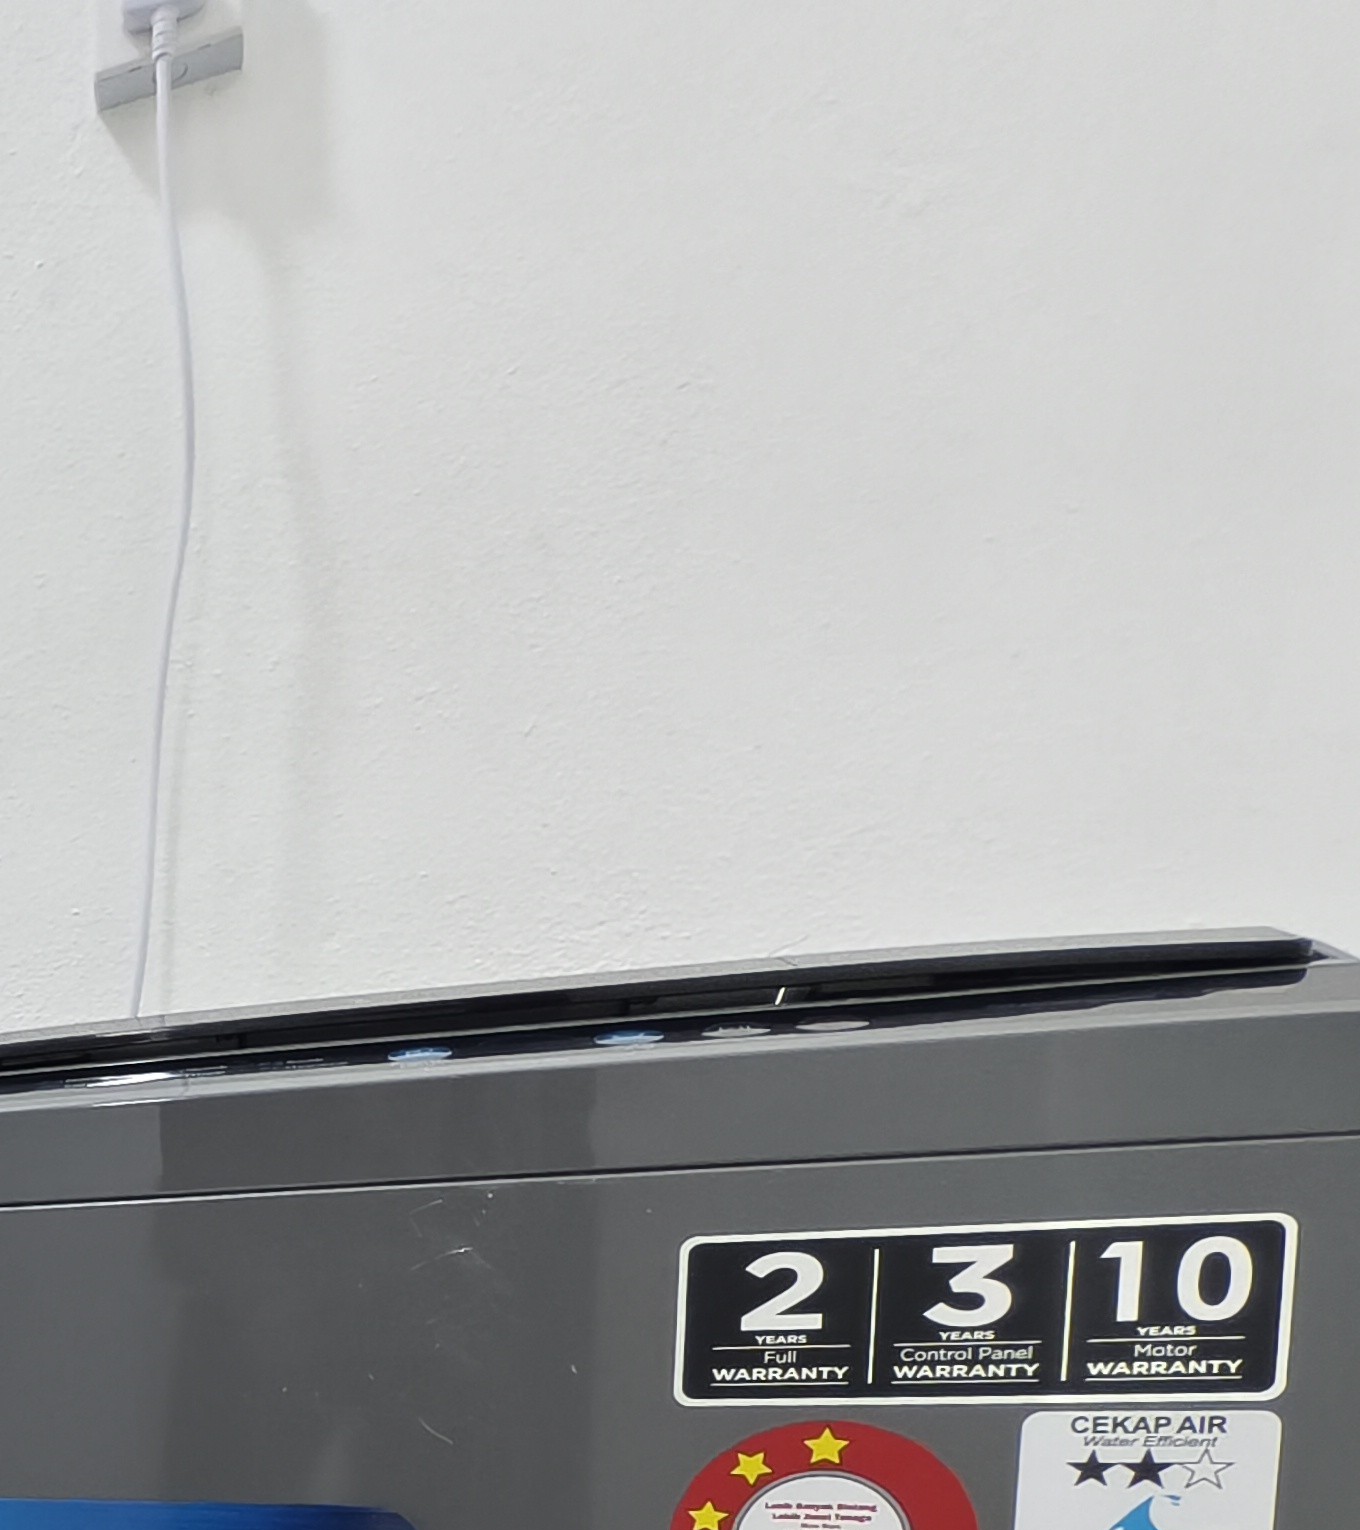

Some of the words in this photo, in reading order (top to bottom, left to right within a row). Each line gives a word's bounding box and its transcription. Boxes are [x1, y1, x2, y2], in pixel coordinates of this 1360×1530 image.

[922, 1244, 1015, 1327] 3
[1100, 1236, 1253, 1322] 10
[740, 1251, 824, 1331] 2
[939, 1330, 996, 1341] YEARS
[1137, 1325, 1197, 1336] YEARS
[755, 1334, 807, 1345] YEARS
[763, 1350, 797, 1364] Full
[899, 1345, 972, 1362] Control
[978, 1345, 1033, 1361] Panel
[1134, 1342, 1197, 1358] Motor
[711, 1367, 849, 1382] WARRANTY
[893, 1362, 1040, 1380] WARRANTY
[1086, 1358, 1242, 1376] WARRANTY
[1070, 1416, 1171, 1435] CEKAP
[1175, 1415, 1227, 1434] AIR
[1082, 1435, 1138, 1447] Water
[1143, 1436, 1218, 1447] Efficient
